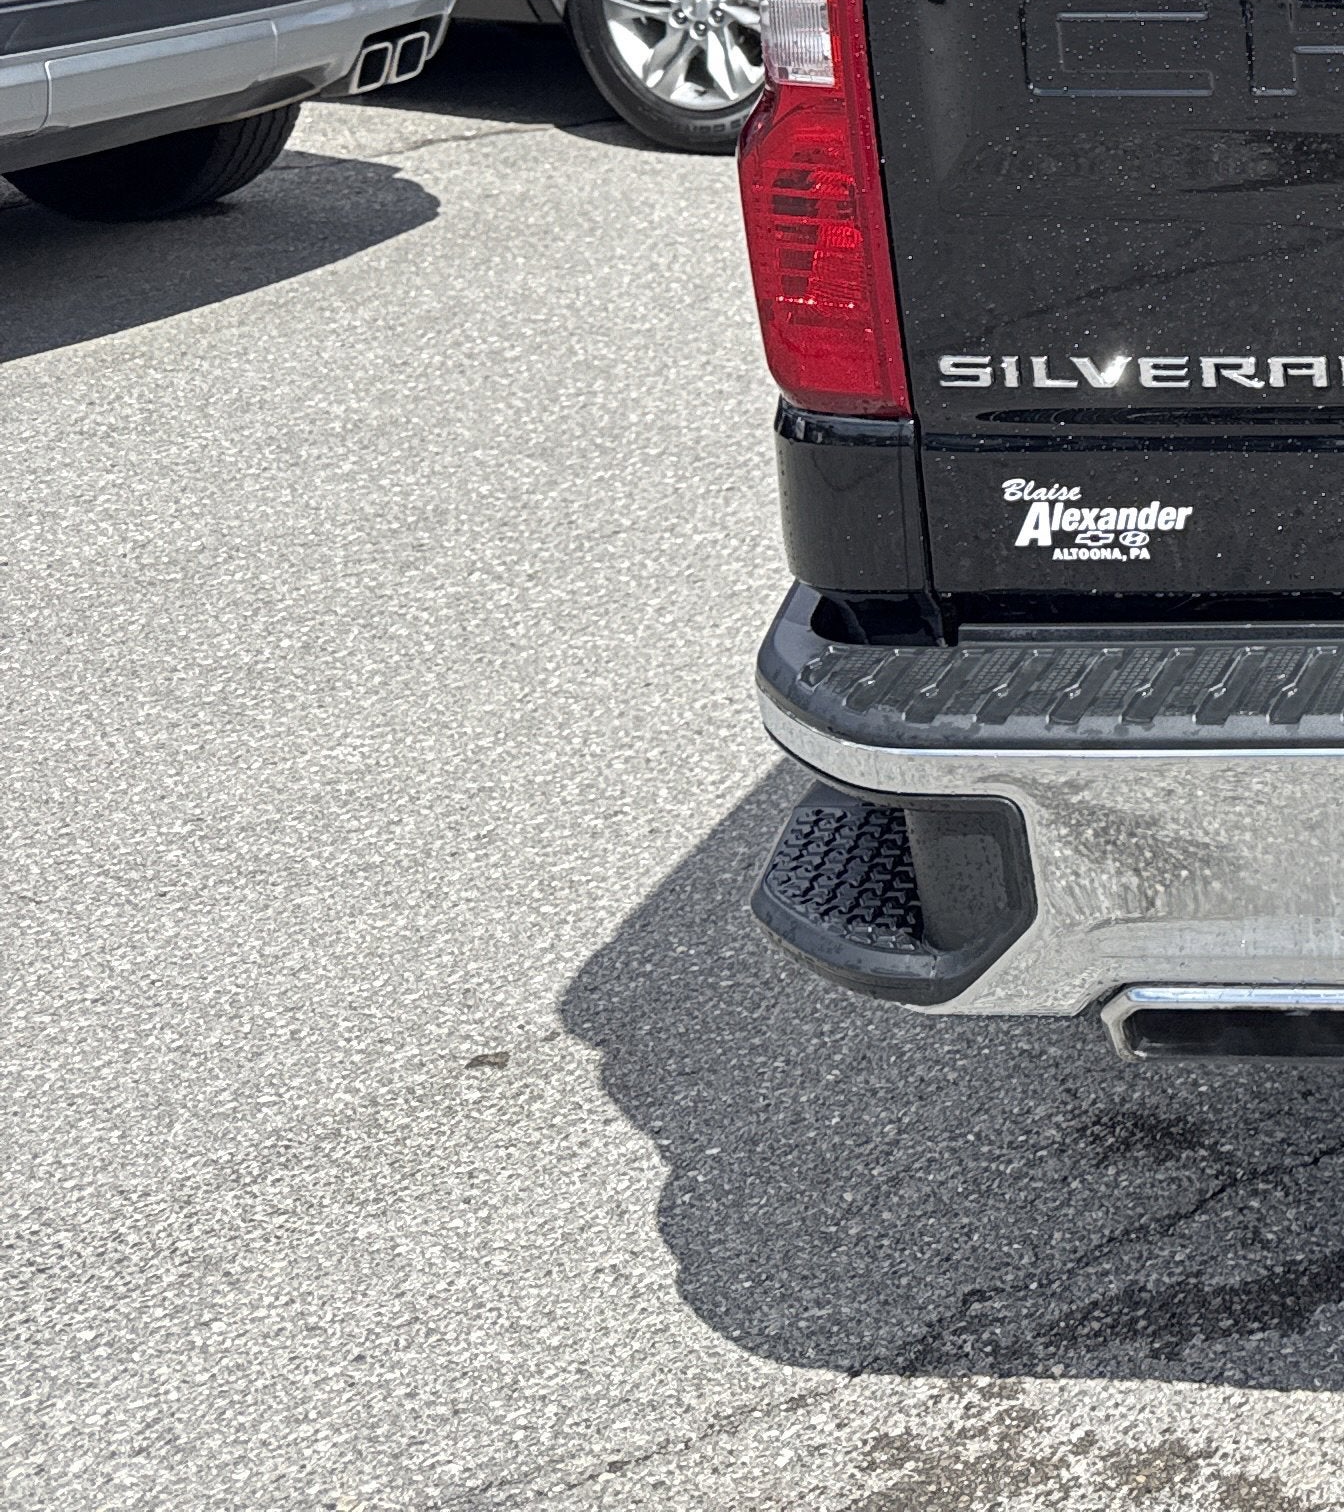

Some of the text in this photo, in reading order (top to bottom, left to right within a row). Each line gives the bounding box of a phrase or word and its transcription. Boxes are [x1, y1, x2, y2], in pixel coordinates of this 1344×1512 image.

[1001, 478, 1082, 501] Blaise
[1014, 501, 1194, 547] Alexander
[1052, 547, 1151, 562] ALTOONA, PA
